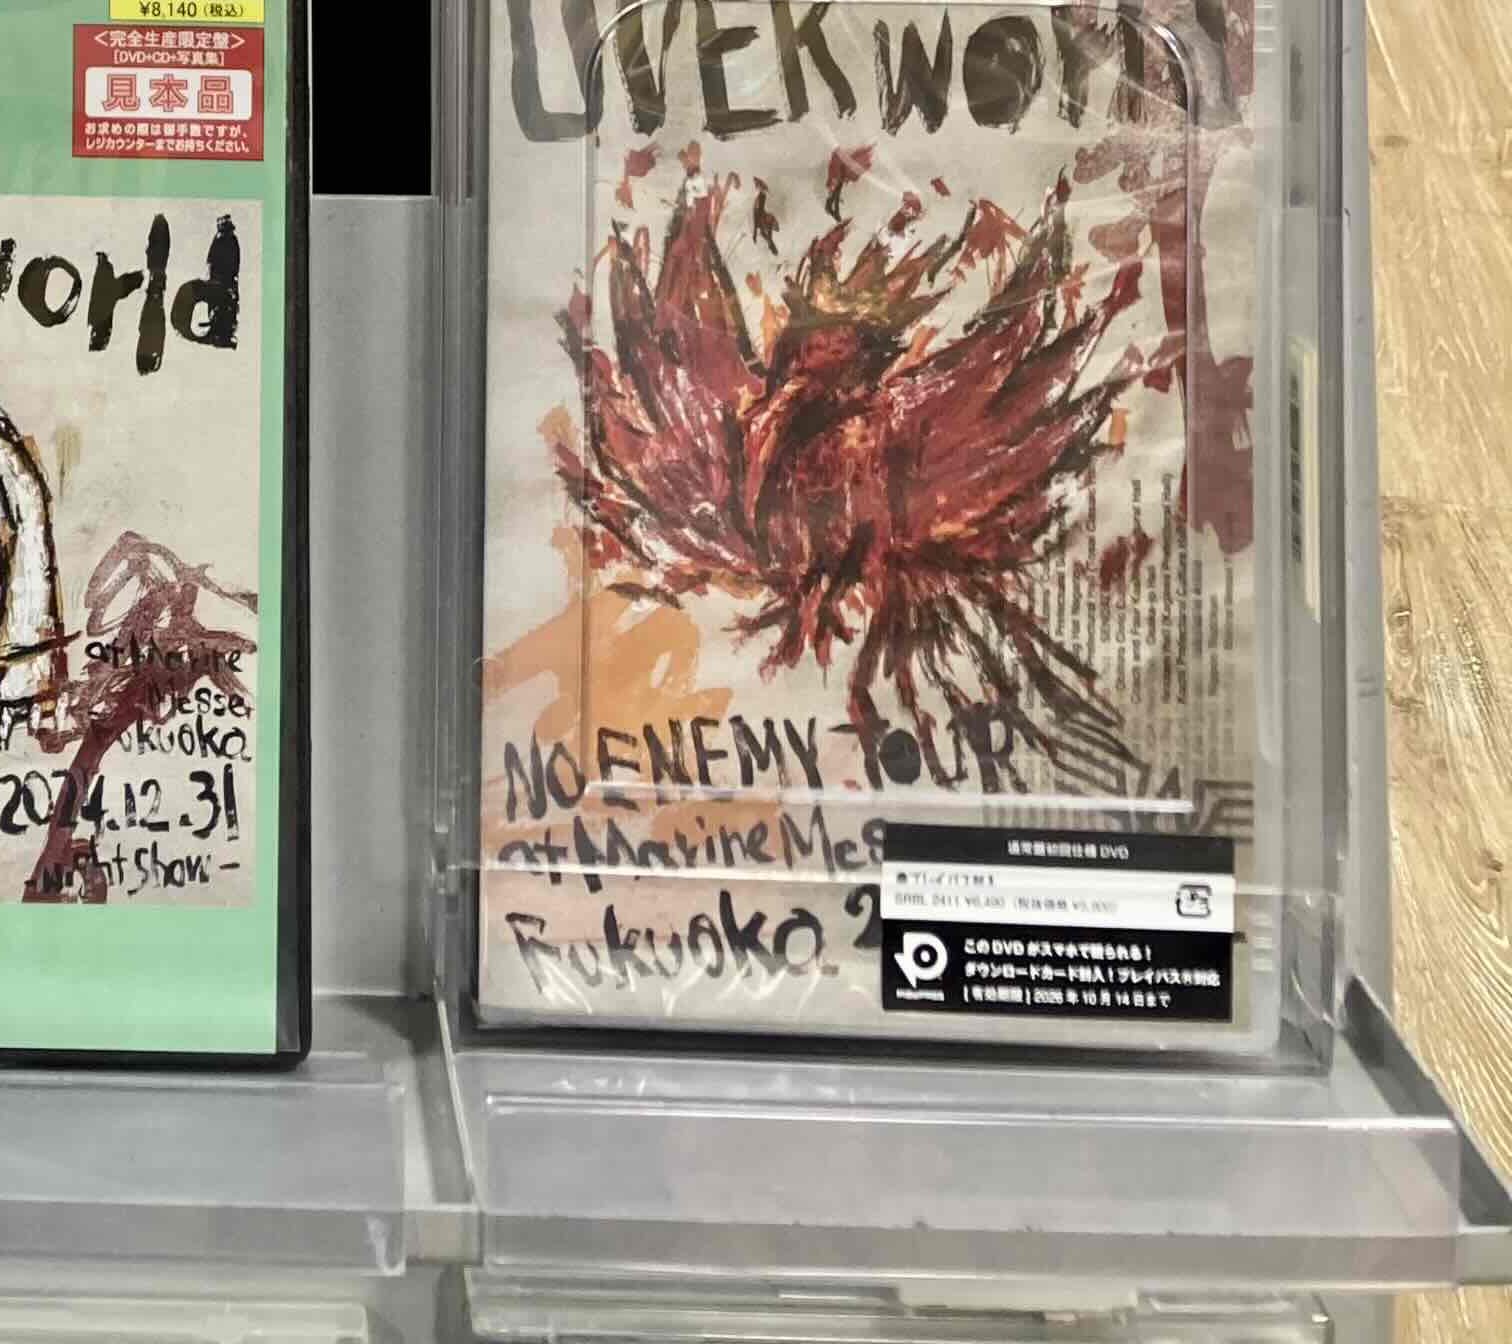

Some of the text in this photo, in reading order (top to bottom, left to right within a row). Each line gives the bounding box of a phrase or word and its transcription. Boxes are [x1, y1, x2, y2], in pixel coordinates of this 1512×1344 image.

[139, 2, 197, 18] ¥8,140
[102, 73, 233, 113] 見本品
